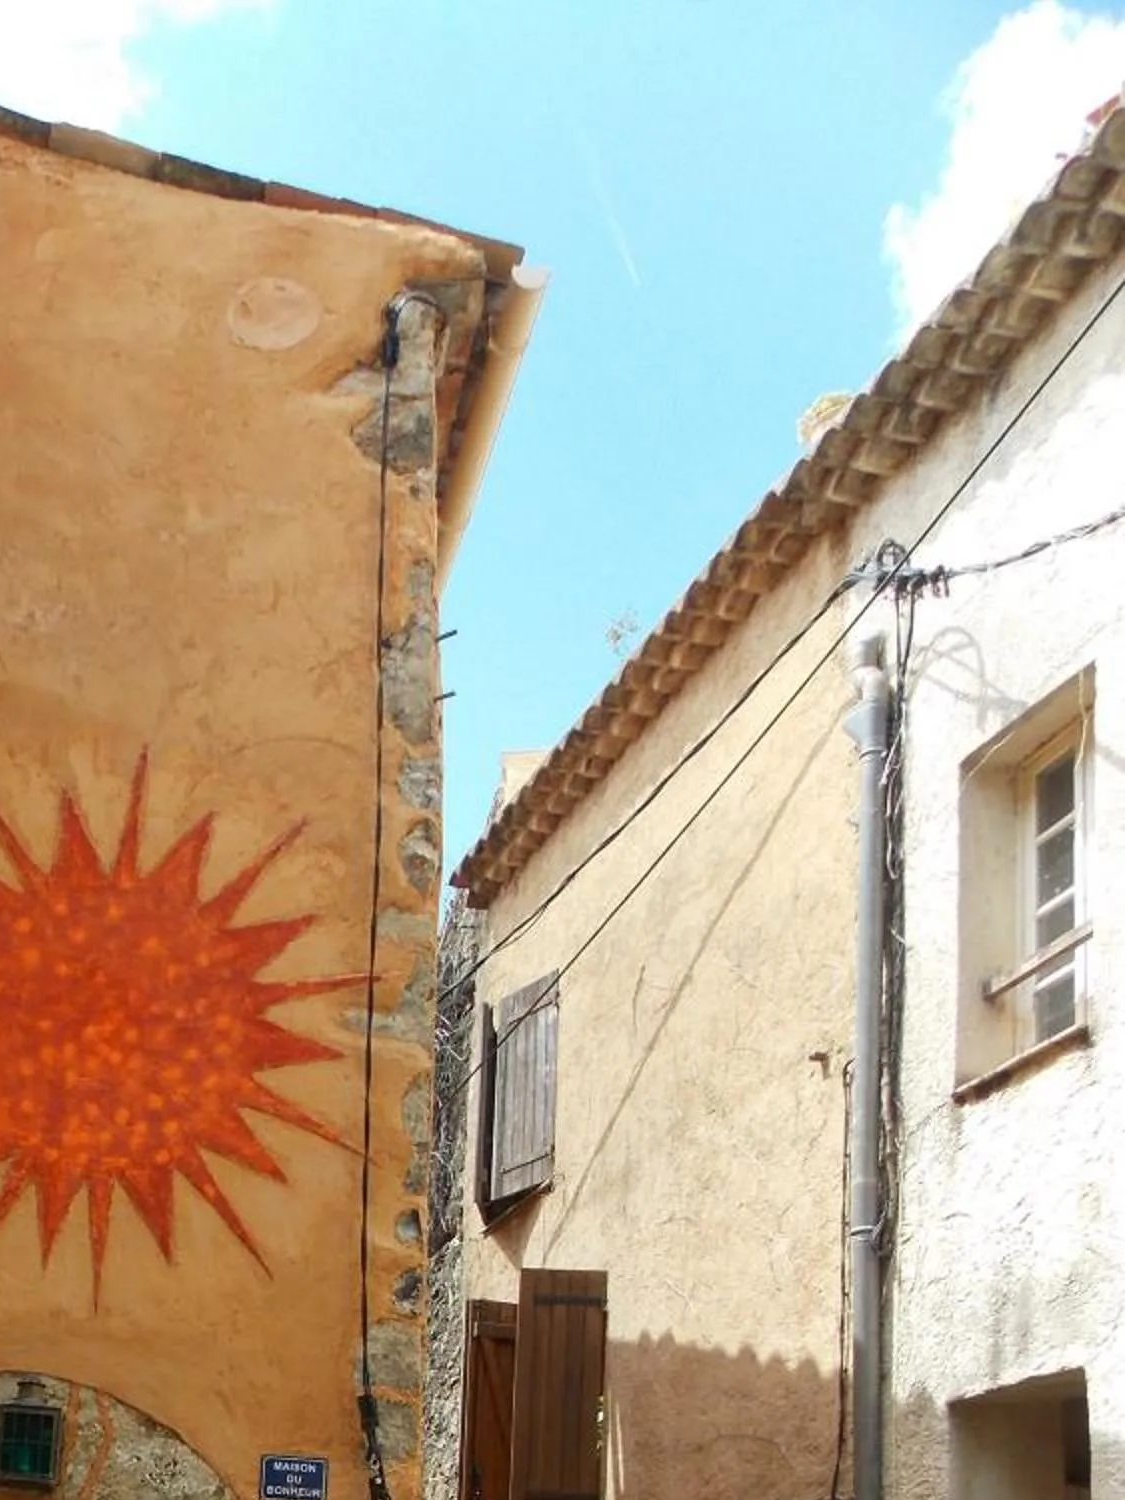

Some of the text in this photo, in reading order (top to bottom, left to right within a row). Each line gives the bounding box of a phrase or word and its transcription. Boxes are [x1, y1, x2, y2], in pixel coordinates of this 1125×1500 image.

[273, 1462, 316, 1472] MAISON
[286, 1474, 302, 1484] DU
[266, 1485, 320, 1497] BONHEUR
